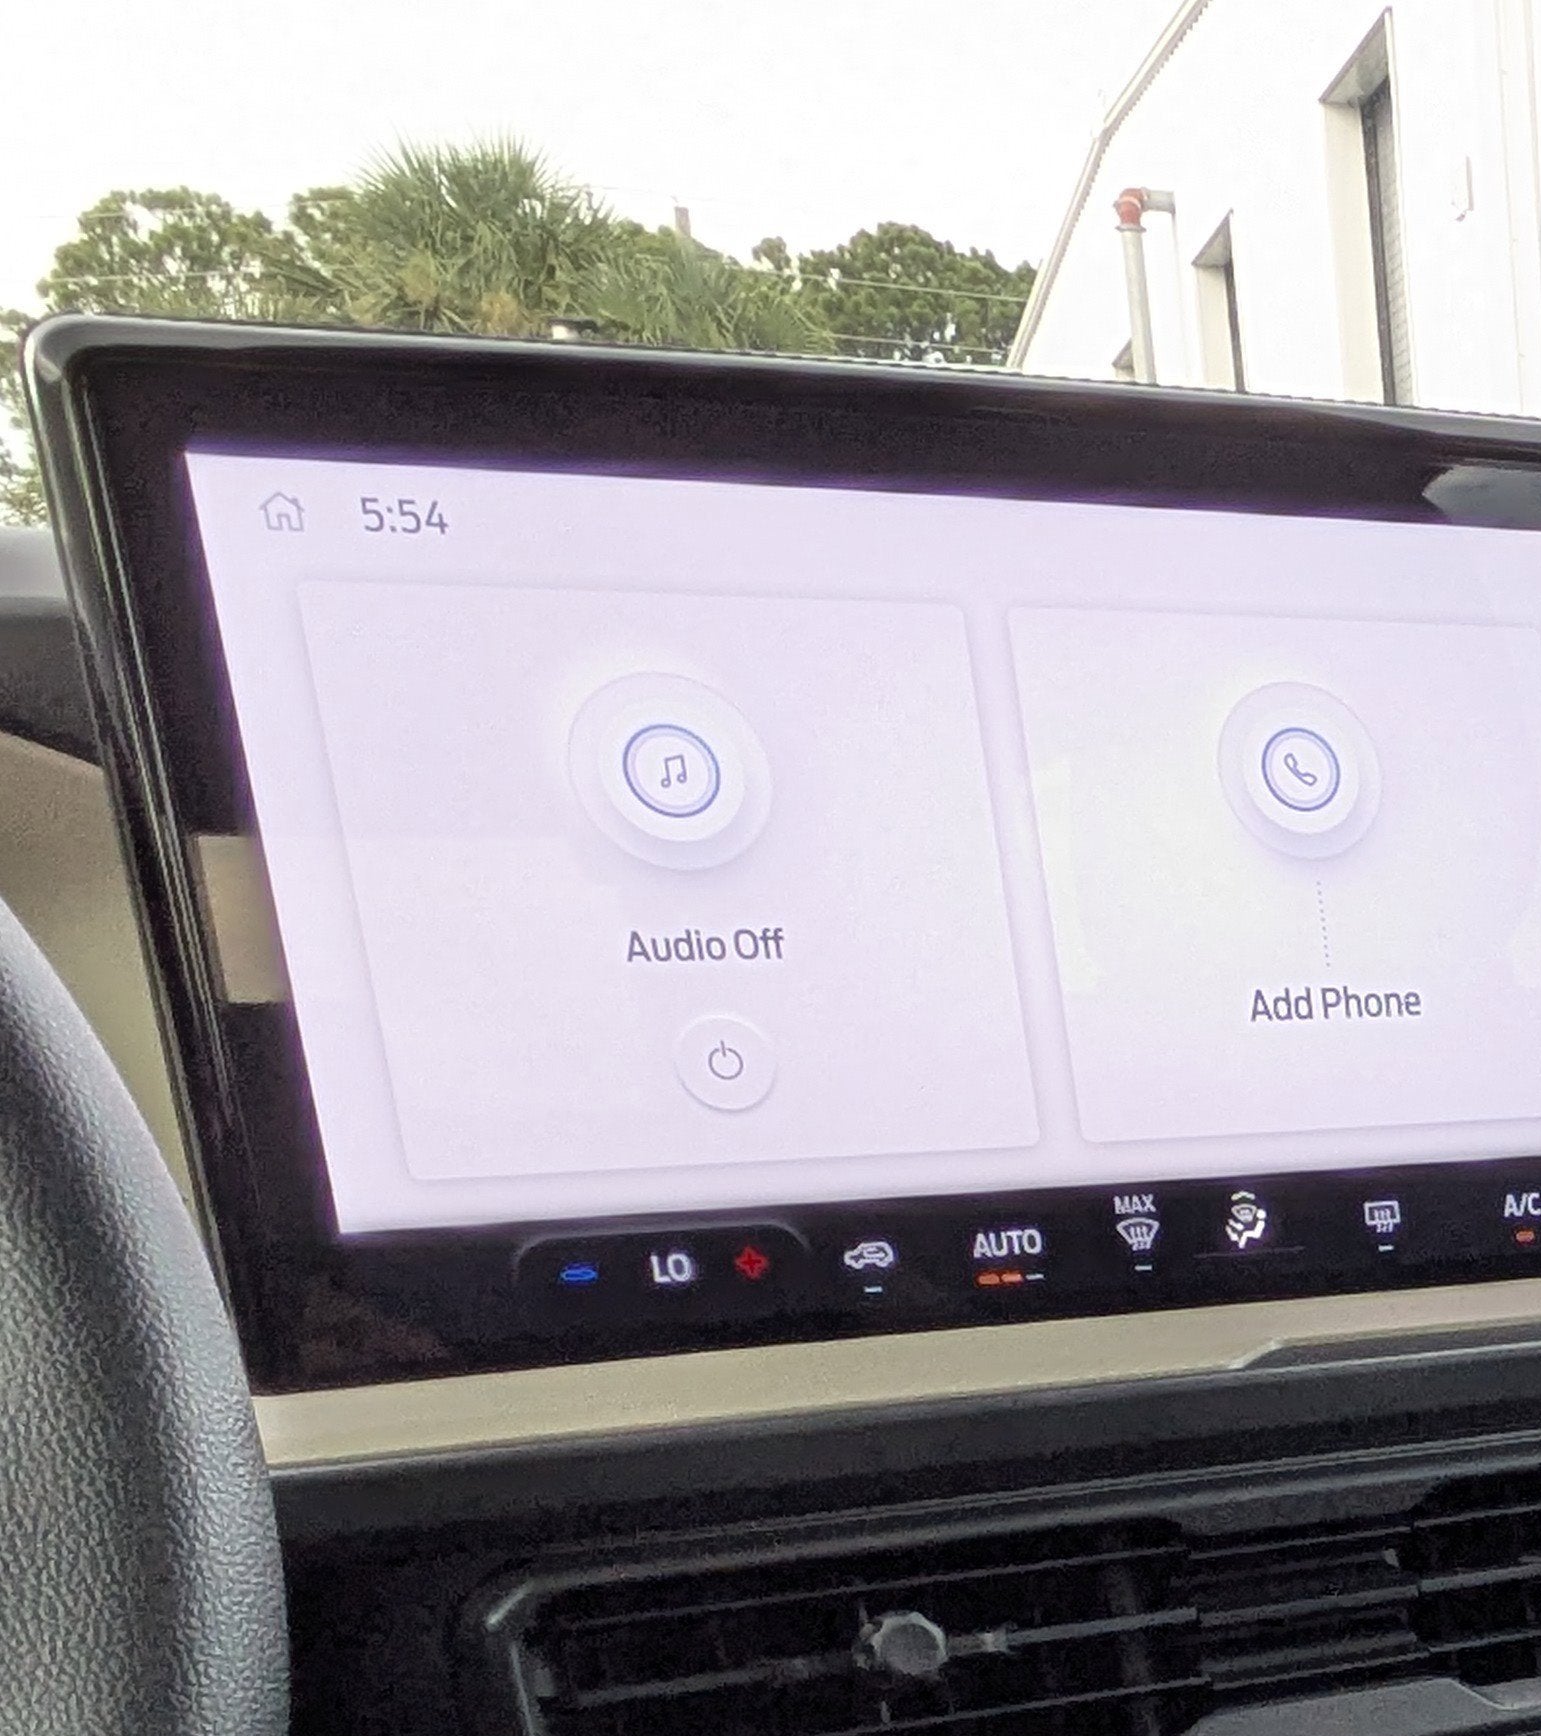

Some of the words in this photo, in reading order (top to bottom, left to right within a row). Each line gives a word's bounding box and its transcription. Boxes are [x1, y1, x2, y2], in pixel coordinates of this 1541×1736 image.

[360, 496, 449, 535] 5:54
[627, 929, 726, 962] Audio
[734, 927, 784, 960] Off
[1251, 986, 1313, 1022] Add
[1321, 985, 1421, 1018] Phone
[1113, 1193, 1156, 1215] MAX
[1504, 1192, 1541, 1218] A/C
[973, 1229, 1042, 1260] AUTO
[650, 1253, 692, 1283] LO
